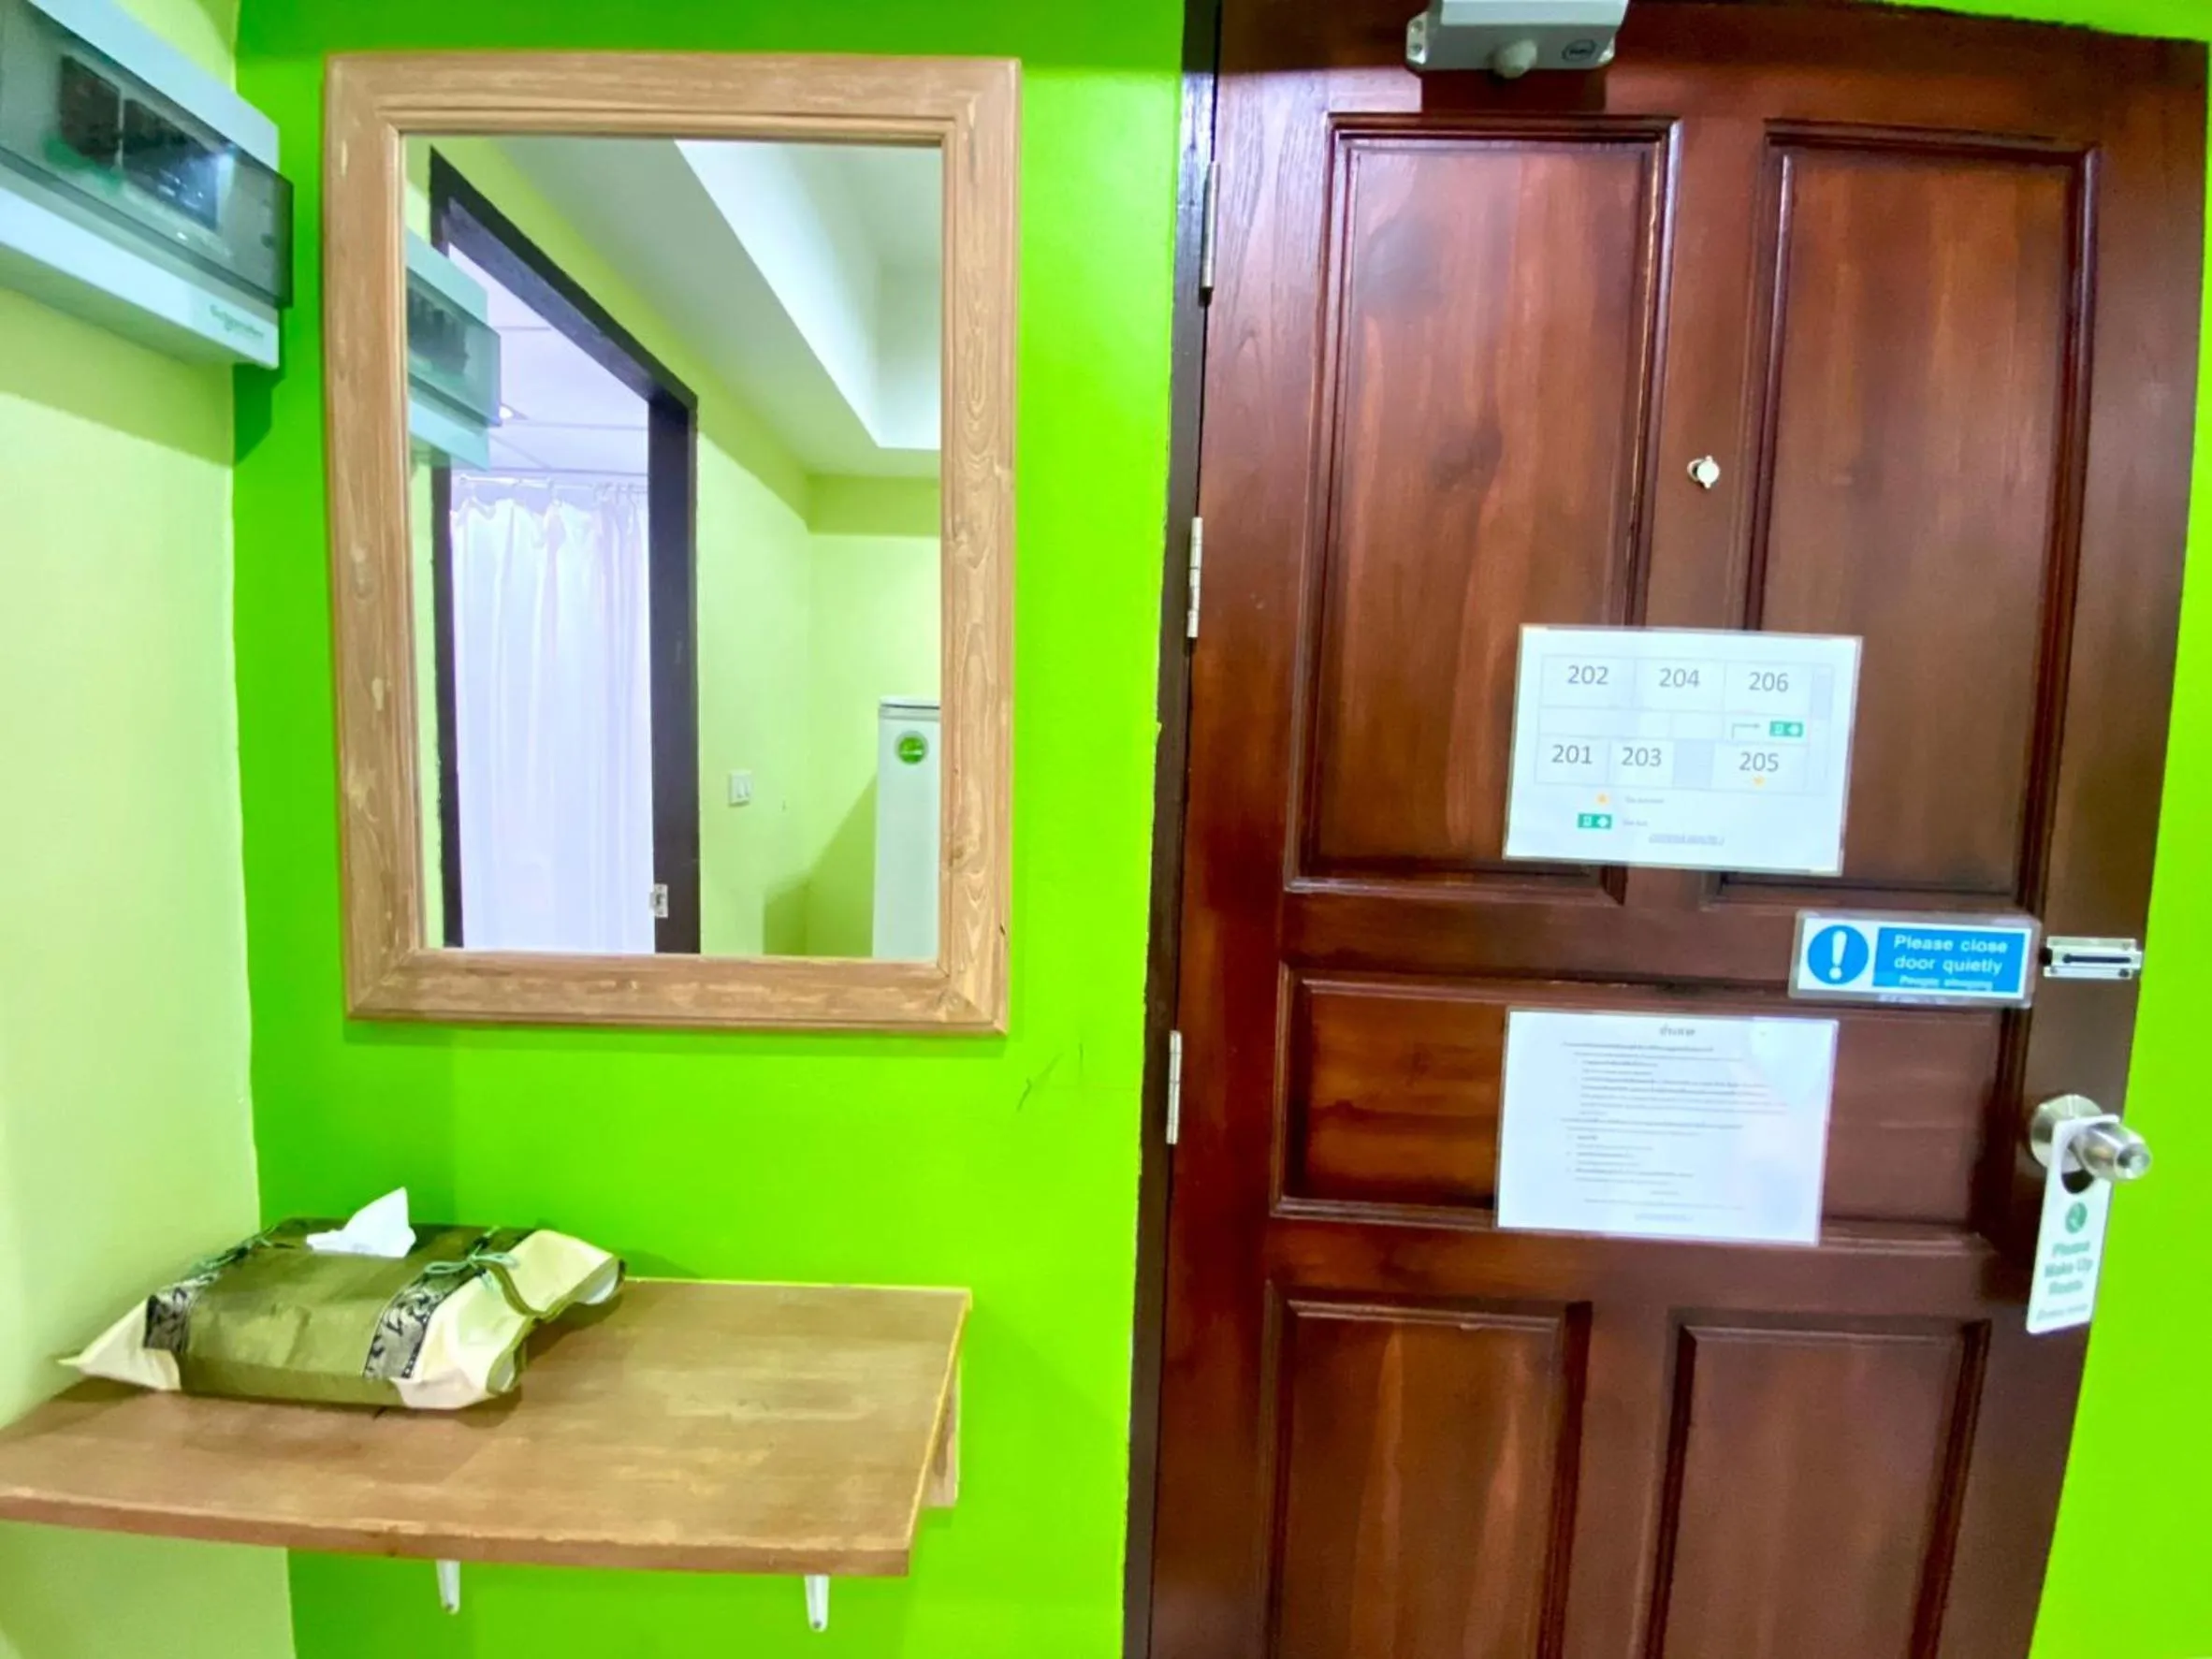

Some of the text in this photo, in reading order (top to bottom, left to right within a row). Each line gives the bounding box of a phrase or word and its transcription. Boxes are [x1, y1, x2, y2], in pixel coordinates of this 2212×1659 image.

[1567, 664, 1608, 685] 202
[1659, 667, 1700, 688] 204
[1749, 672, 1789, 692] 206
[1552, 744, 1593, 764] 201
[1622, 747, 1662, 767] 203
[1739, 752, 1780, 773] 205
[1894, 934, 2008, 953] Please close
[1894, 954, 2002, 976] door quietly
